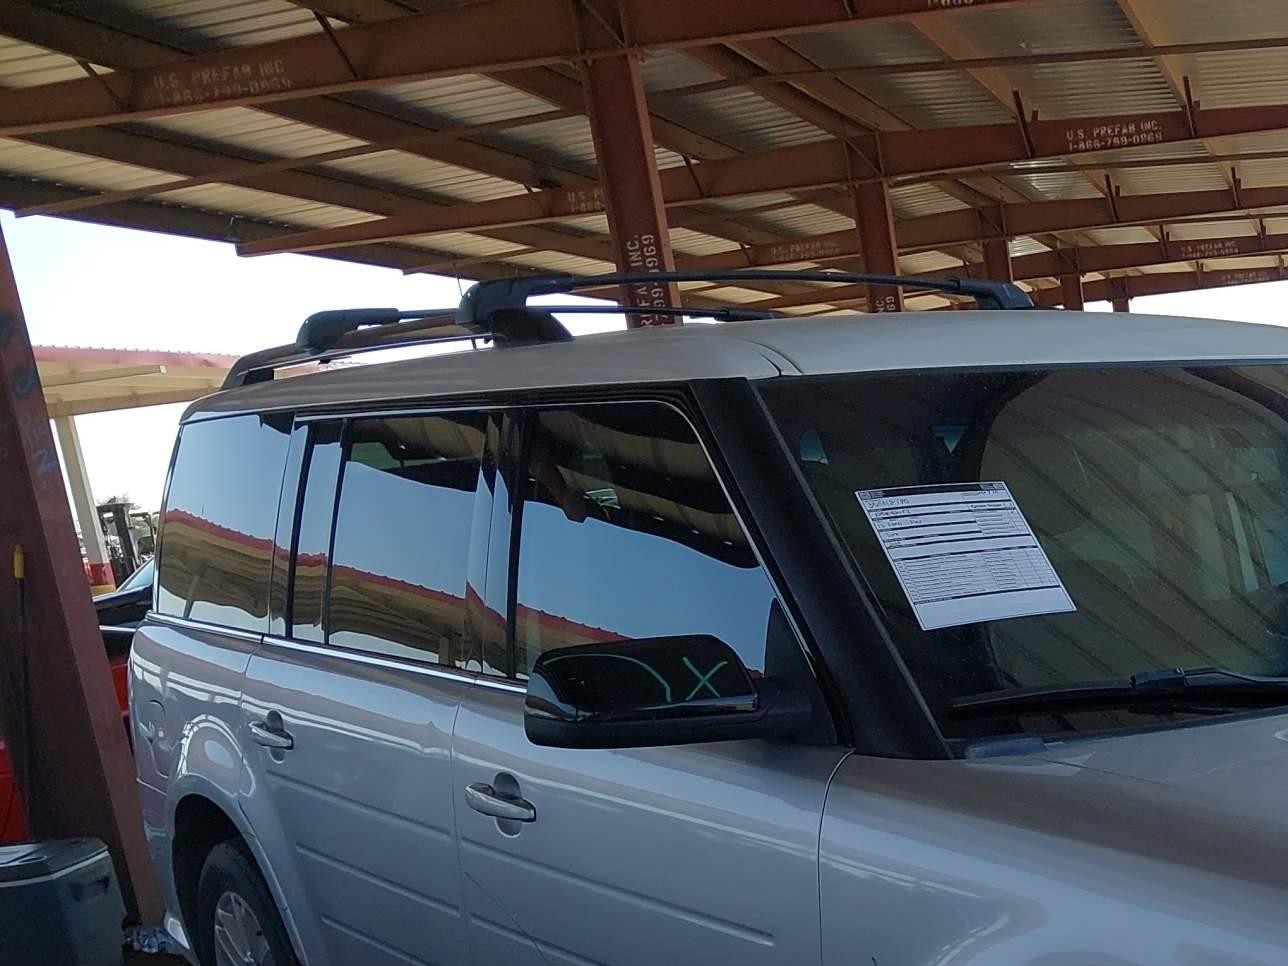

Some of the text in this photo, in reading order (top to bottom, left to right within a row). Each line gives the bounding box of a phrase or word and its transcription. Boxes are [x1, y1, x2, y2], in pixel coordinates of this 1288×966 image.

[1092, 122, 1136, 137] PREFAB
[1140, 119, 1162, 131] INC.
[1068, 131, 1163, 151] 1-866-799-0969
[626, 234, 643, 267] INC.
